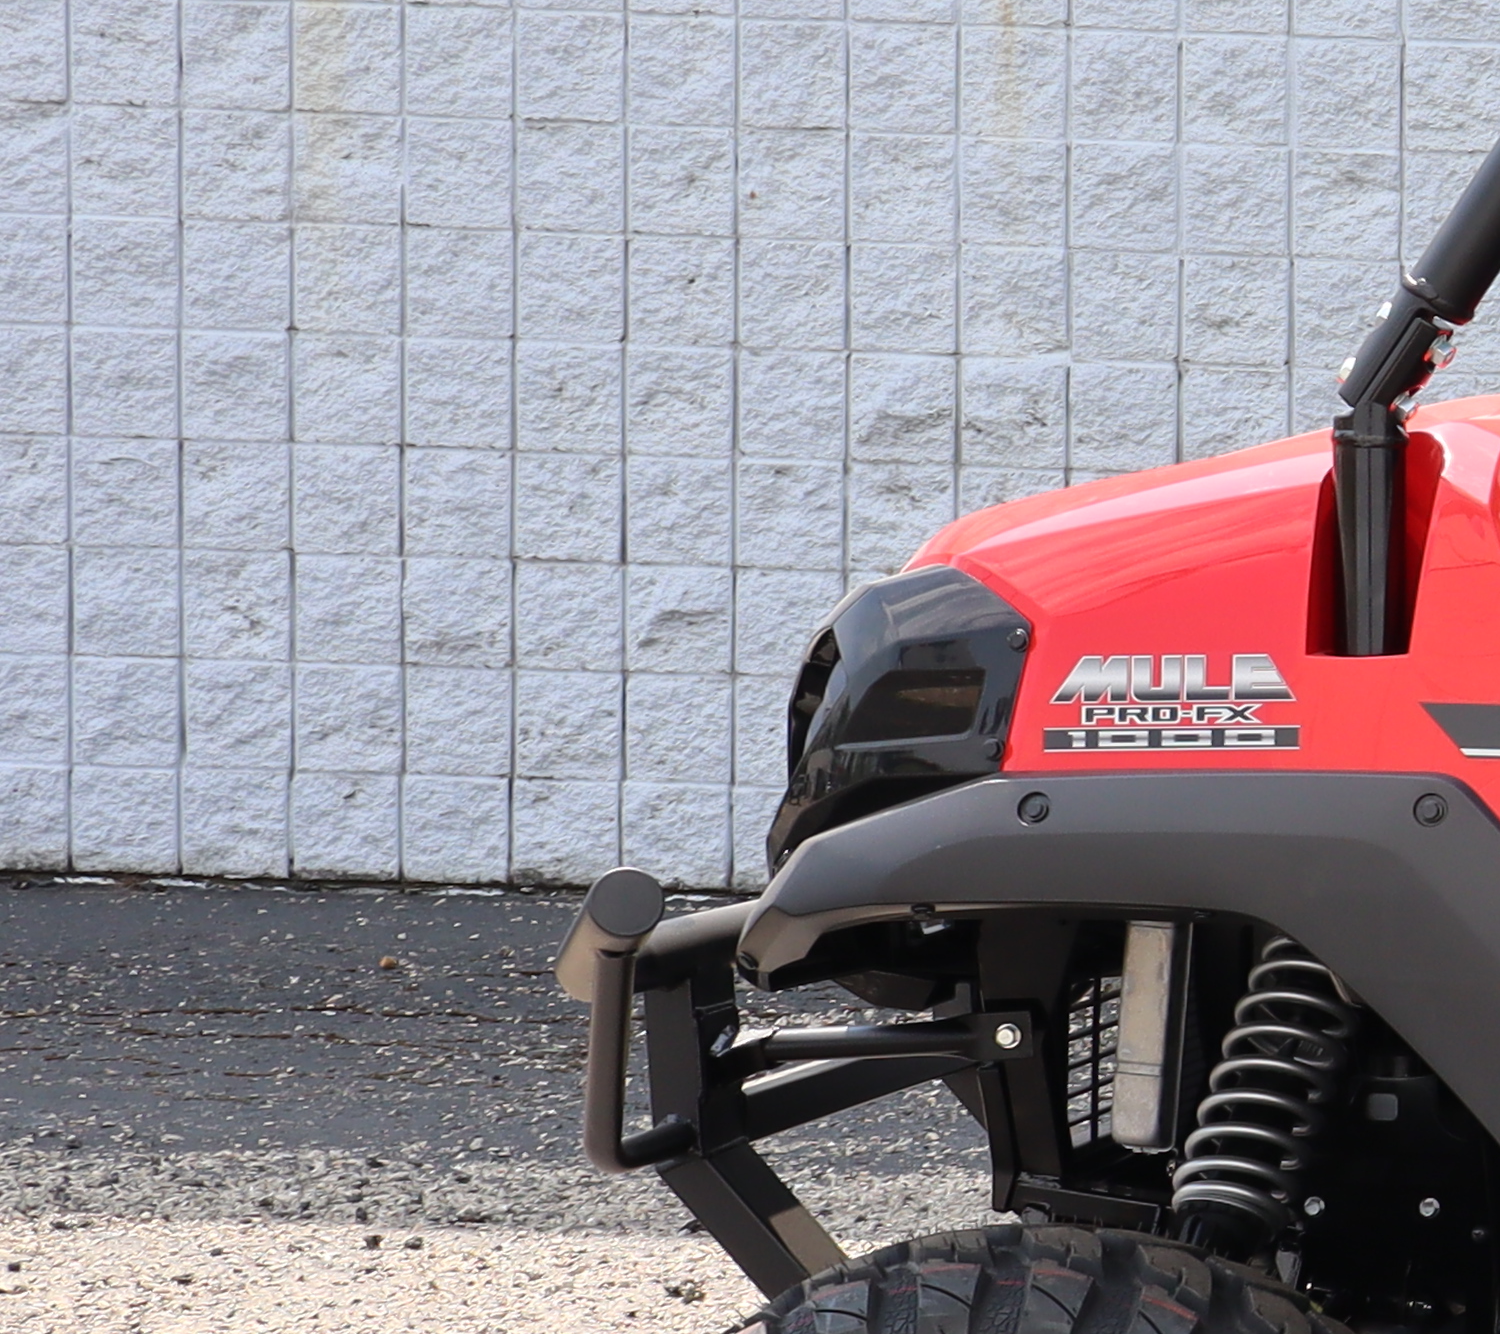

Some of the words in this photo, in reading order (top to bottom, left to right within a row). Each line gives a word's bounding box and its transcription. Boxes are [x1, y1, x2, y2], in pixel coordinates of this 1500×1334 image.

[1049, 653, 1297, 703] MULE
[1080, 703, 1262, 725] PRO-FX
[1067, 728, 1278, 748] 1000
